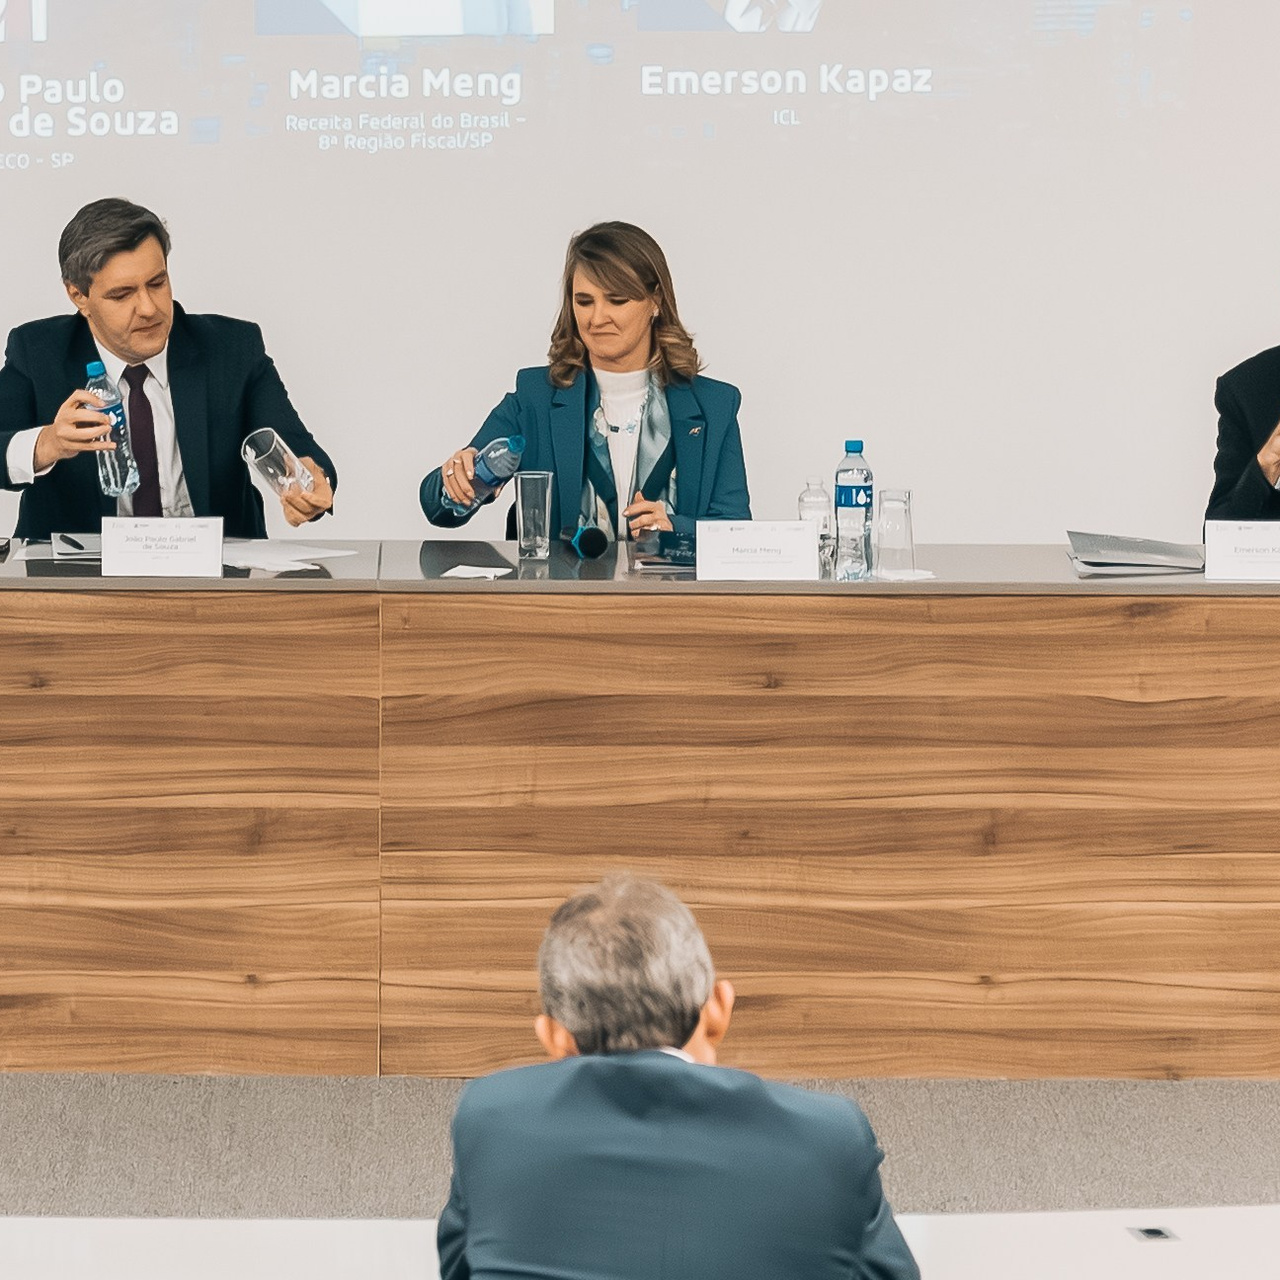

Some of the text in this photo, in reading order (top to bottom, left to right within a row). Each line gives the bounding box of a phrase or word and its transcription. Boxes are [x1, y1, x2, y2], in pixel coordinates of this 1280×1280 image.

[20, 71, 124, 104] Paulo
[290, 65, 521, 106] Marcia Meng
[641, 63, 932, 101] Emerson Kapaz
[9, 105, 54, 137] de
[67, 106, 179, 136] Souza
[285, 114, 353, 132] Receita
[358, 112, 425, 130] Federal
[431, 113, 454, 129] do
[460, 111, 511, 129] Brasil
[773, 109, 801, 126] ICL
[343, 132, 405, 154] Região
[410, 130, 493, 150] Fiscal/SP
[50, 152, 75, 168] SP
